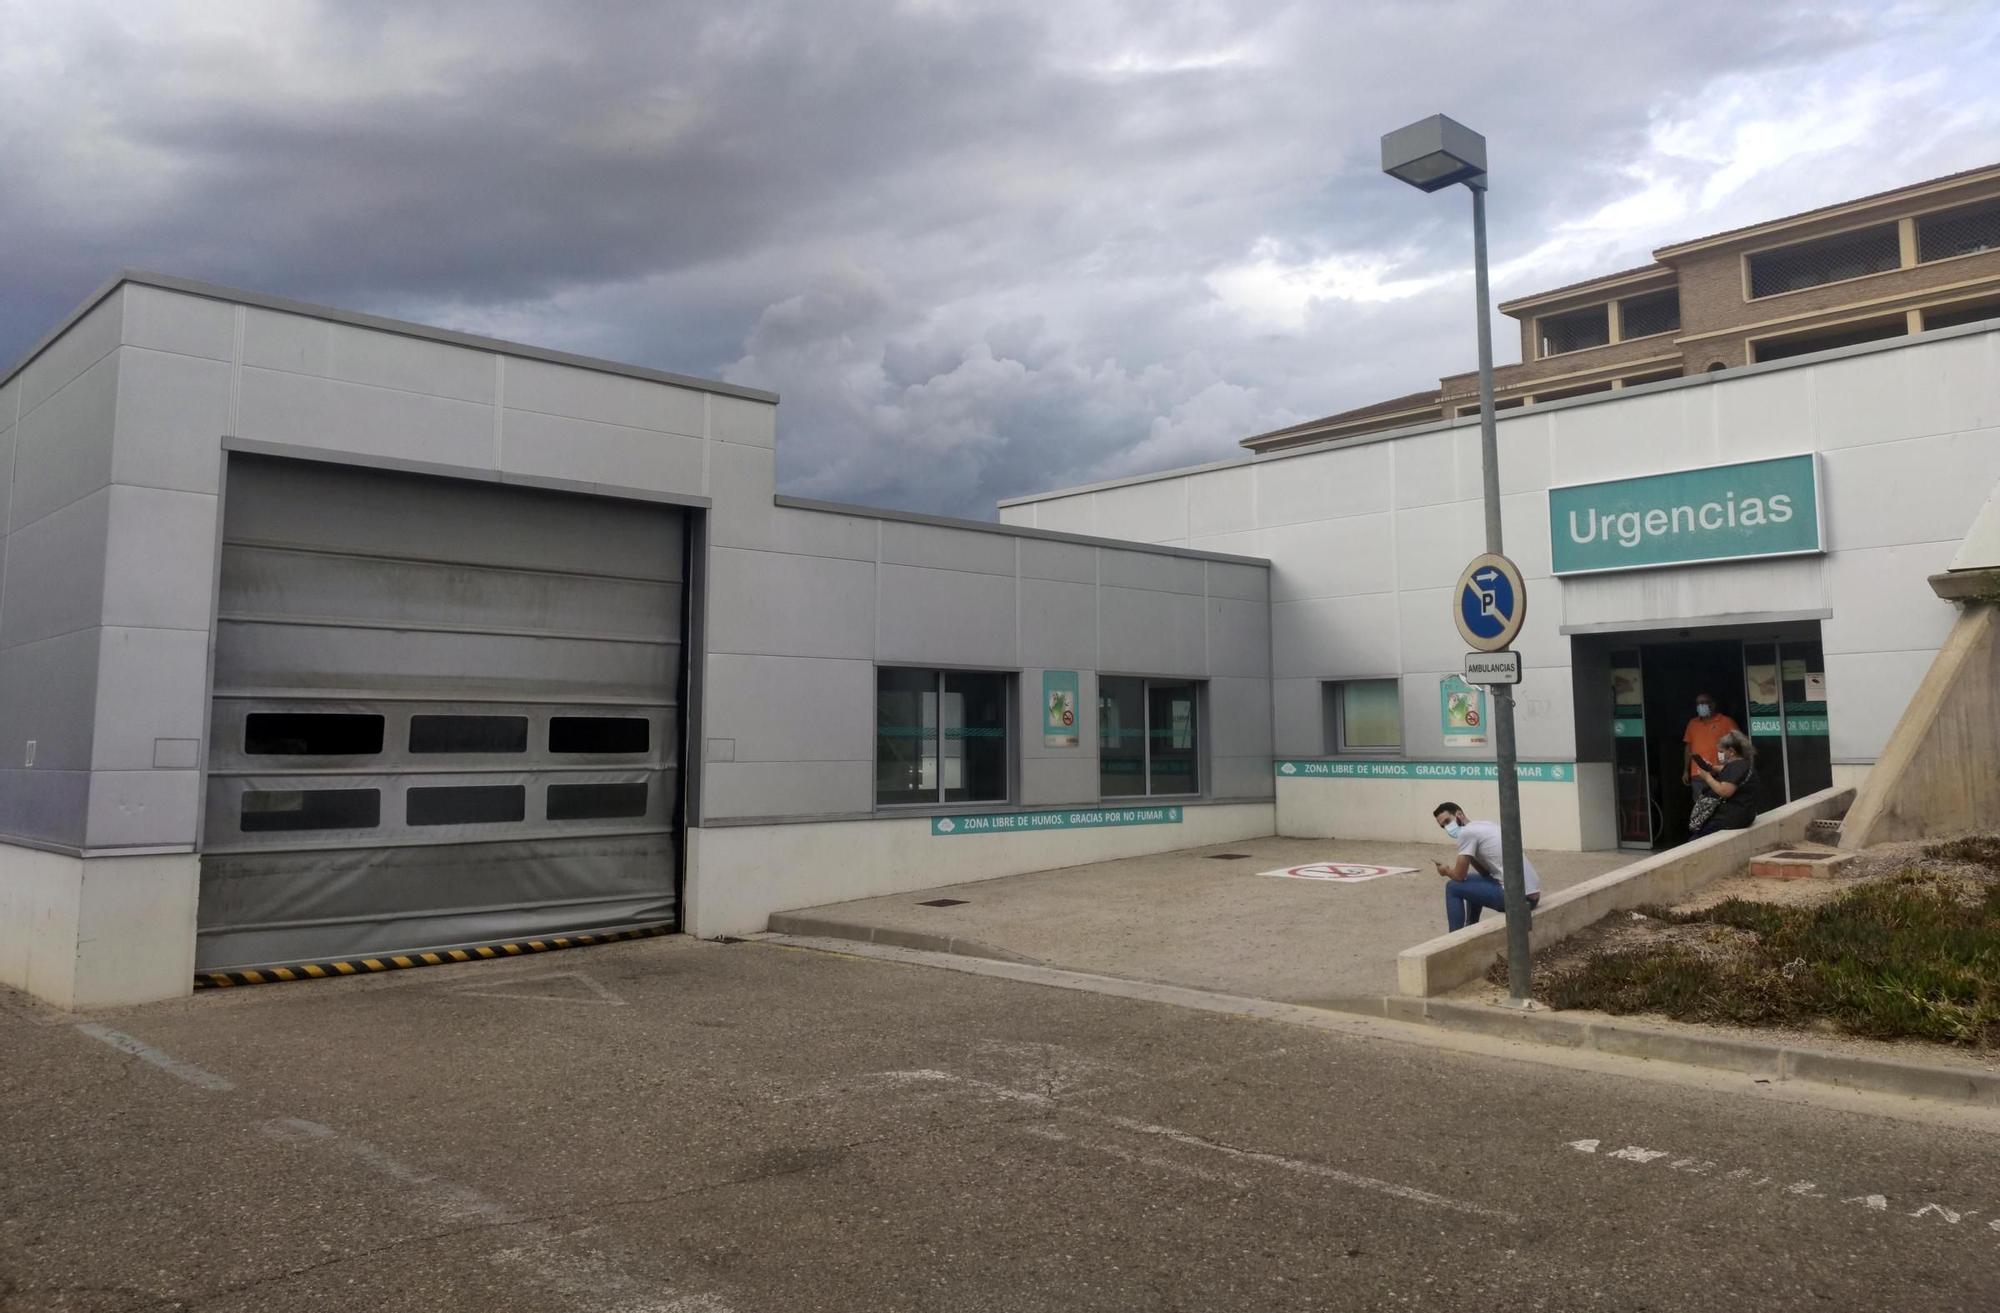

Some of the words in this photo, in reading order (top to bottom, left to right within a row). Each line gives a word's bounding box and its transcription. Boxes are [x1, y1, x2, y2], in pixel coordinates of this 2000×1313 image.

[1569, 491, 1793, 547] Urgencias
[1482, 592, 1494, 613] P
[1468, 663, 1515, 673] AMBULANCIAS
[1751, 720, 1780, 731] GRACIAS
[1786, 720, 1797, 731] OR
[1304, 764, 1328, 774] ZONA
[1332, 764, 1354, 774] LIBRE
[1357, 765, 1368, 774] DE
[1372, 765, 1408, 775] HUMOS.
[1416, 765, 1457, 776] GRACIAS
[1460, 766, 1480, 776] POR
[1515, 766, 1542, 777] MAR
[964, 818, 989, 829] ZONA
[992, 817, 1014, 828] LIBRE
[1017, 816, 1029, 826] DE
[1031, 814, 1064, 826] HUMOS.
[1070, 812, 1103, 824] GRACIAS
[1105, 812, 1120, 822] POR
[1123, 811, 1134, 821] NO
[1137, 810, 1163, 821] FUMAR
